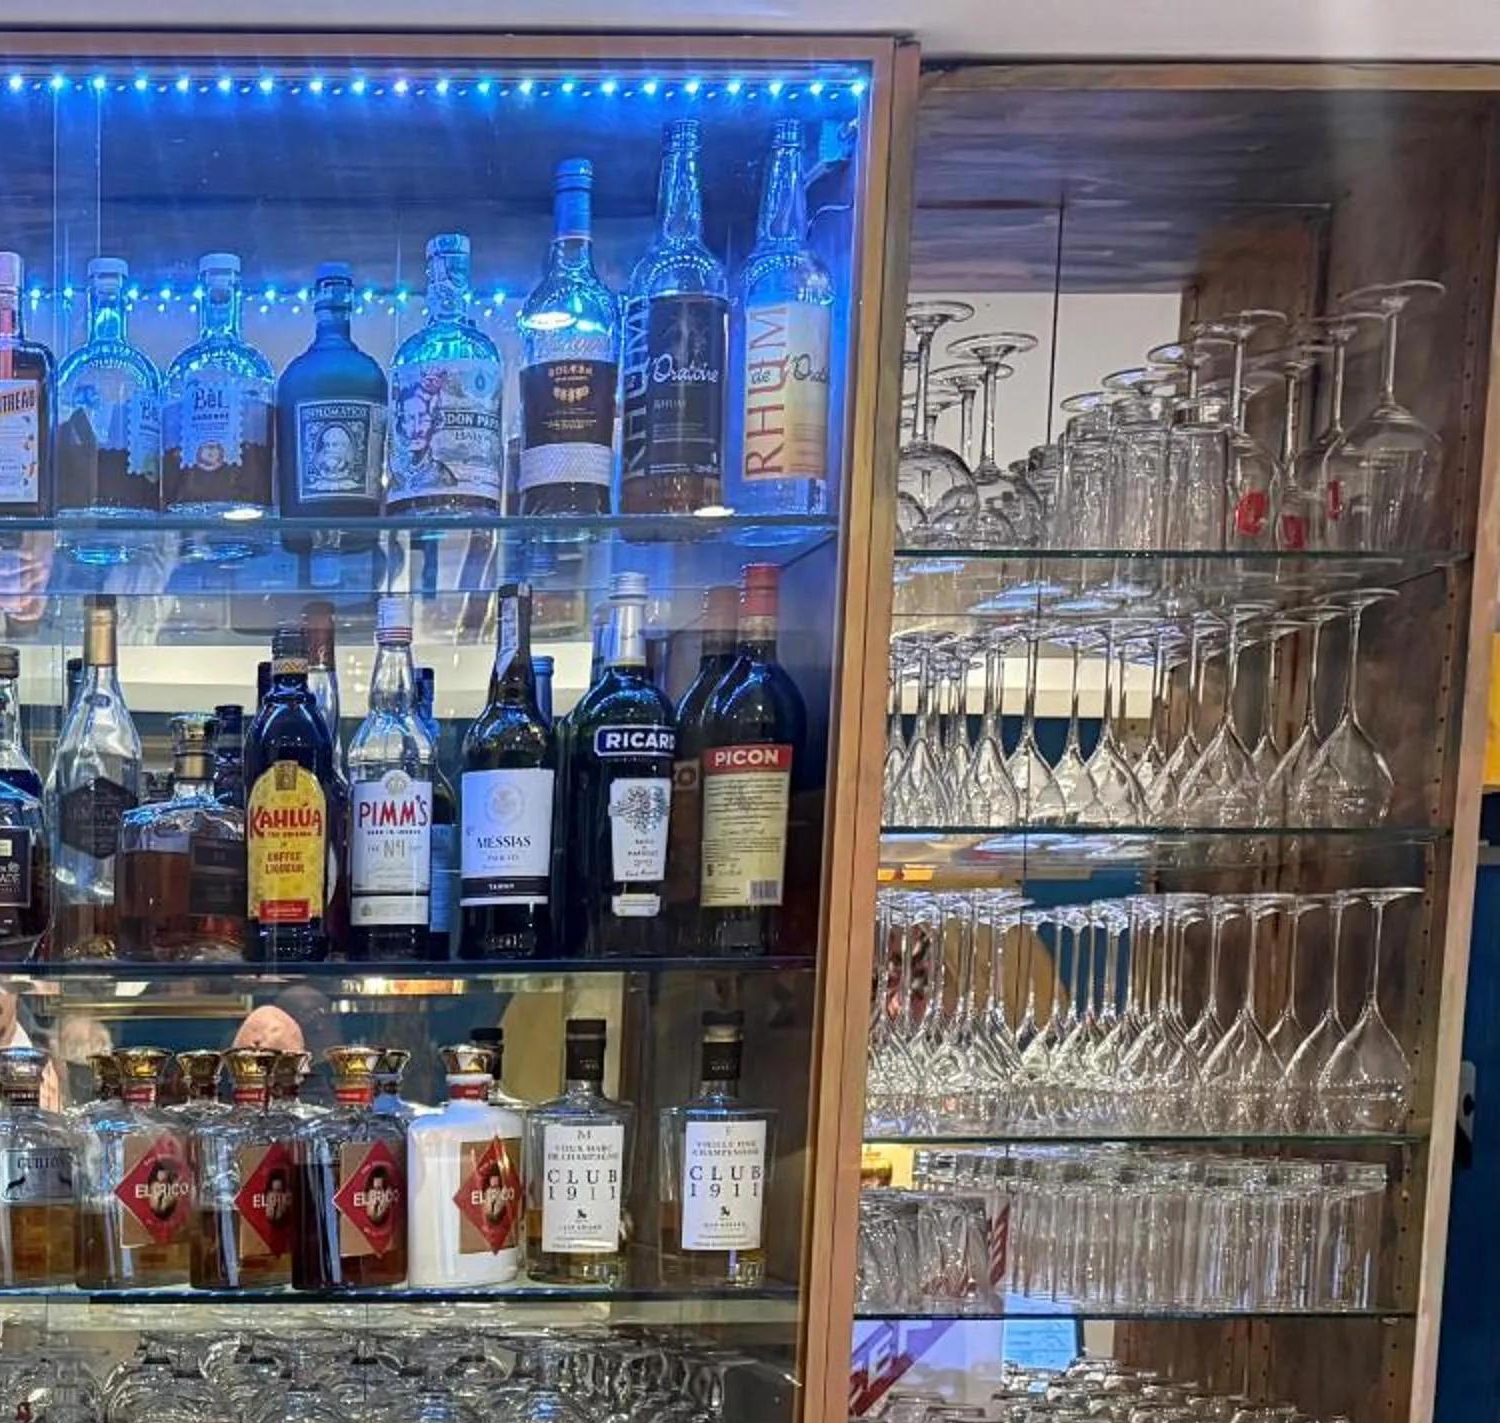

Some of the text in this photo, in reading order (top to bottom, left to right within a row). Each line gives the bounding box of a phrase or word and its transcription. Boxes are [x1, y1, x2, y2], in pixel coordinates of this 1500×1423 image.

[745, 305, 788, 478] RHUM
[444, 411, 474, 425] DON
[605, 731, 675, 750] RICARD
[715, 750, 779, 767] PICON
[359, 794, 429, 828] PIMM'S
[249, 803, 323, 839] KAHLÚA
[476, 835, 532, 849] MESSIAS
[547, 1168, 618, 1185] CLUB
[689, 1165, 762, 1181] CLUB
[548, 1185, 616, 1201] 1911
[691, 1182, 758, 1198] 1911
